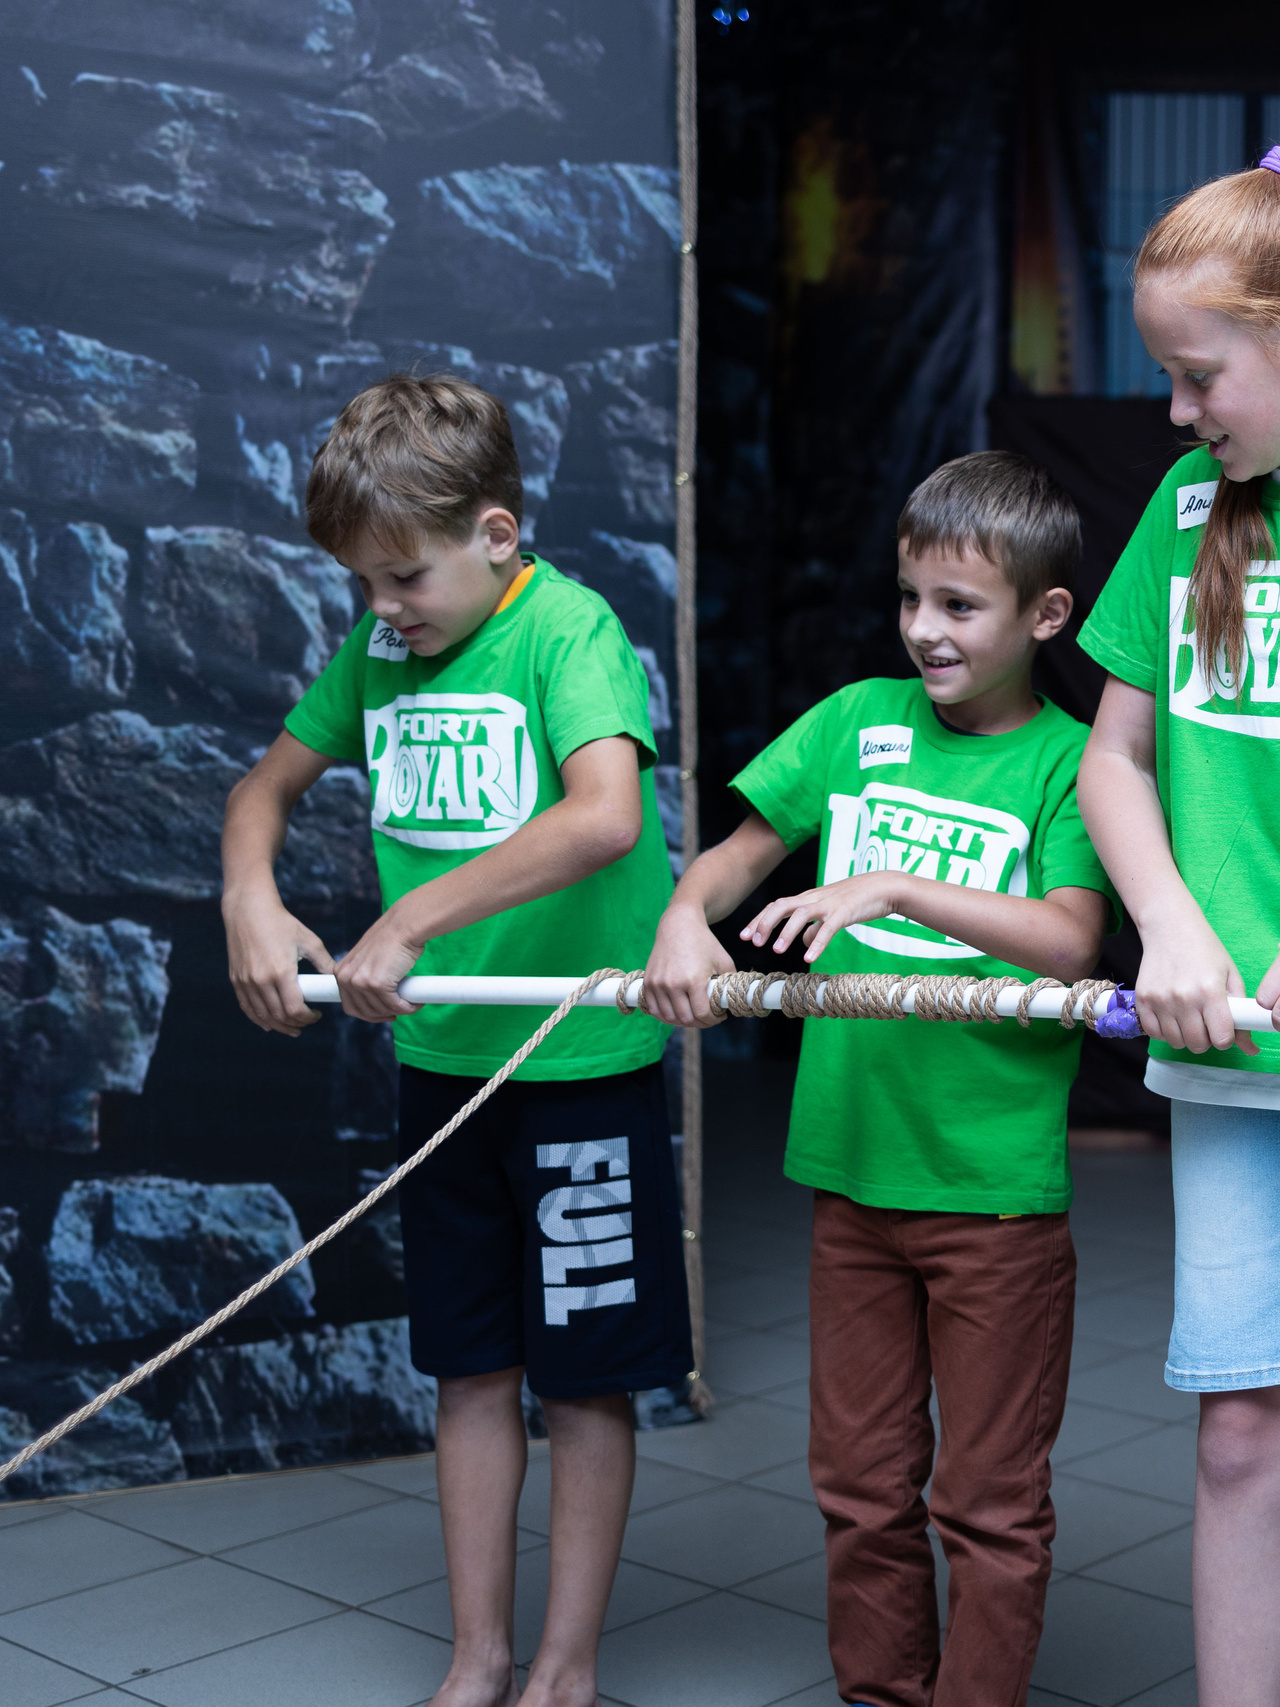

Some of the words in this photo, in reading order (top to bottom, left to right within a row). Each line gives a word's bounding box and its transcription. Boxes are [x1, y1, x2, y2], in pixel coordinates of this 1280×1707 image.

[1180, 495, 1213, 515] Али
[400, 713, 487, 742] FORT
[364, 709, 538, 831] BOYARD
[871, 803, 985, 853] FORT
[536, 1136, 636, 1326] FULL
